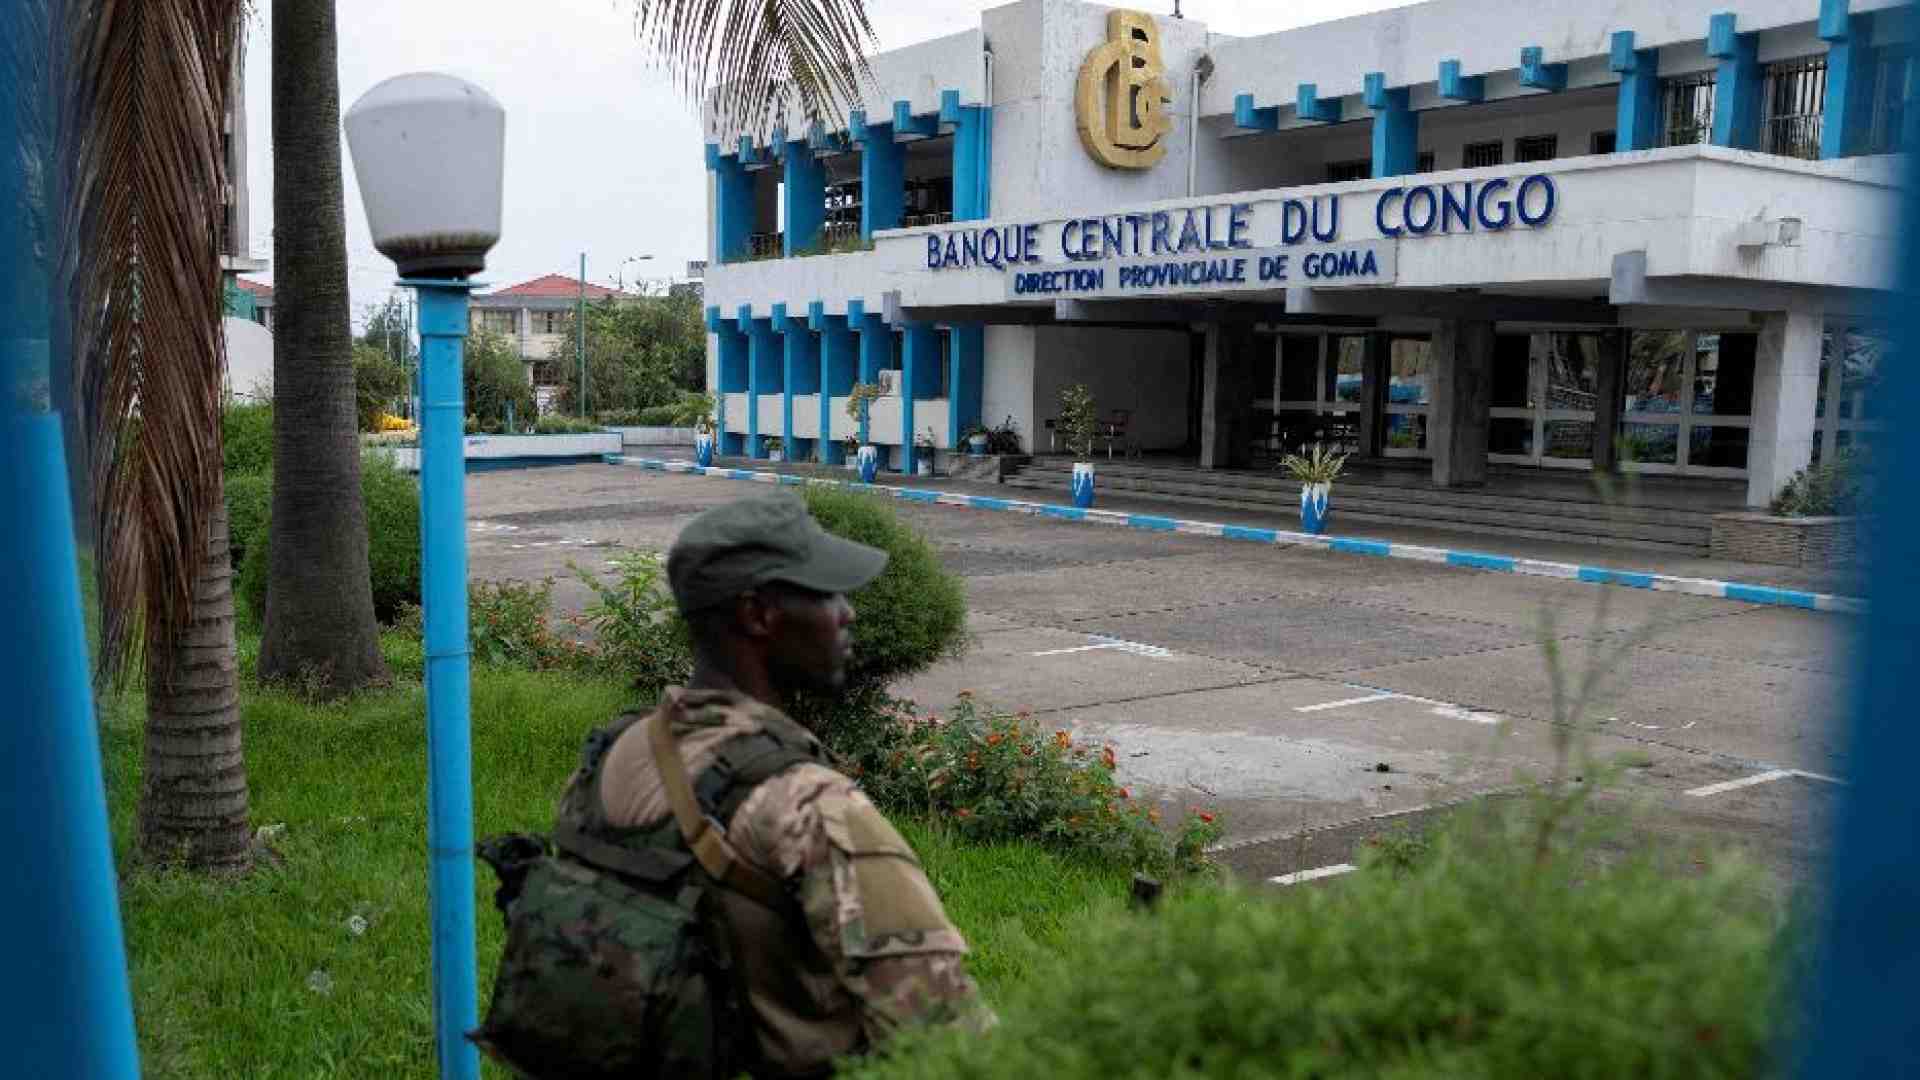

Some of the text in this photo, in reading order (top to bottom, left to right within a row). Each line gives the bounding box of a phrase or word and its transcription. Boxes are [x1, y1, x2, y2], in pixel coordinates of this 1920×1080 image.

[927, 174, 1556, 271] BANQUE CENTRALE DU CONGO
[1014, 249, 1379, 294] DIRECTION PROVINCIALE DE GOMA
